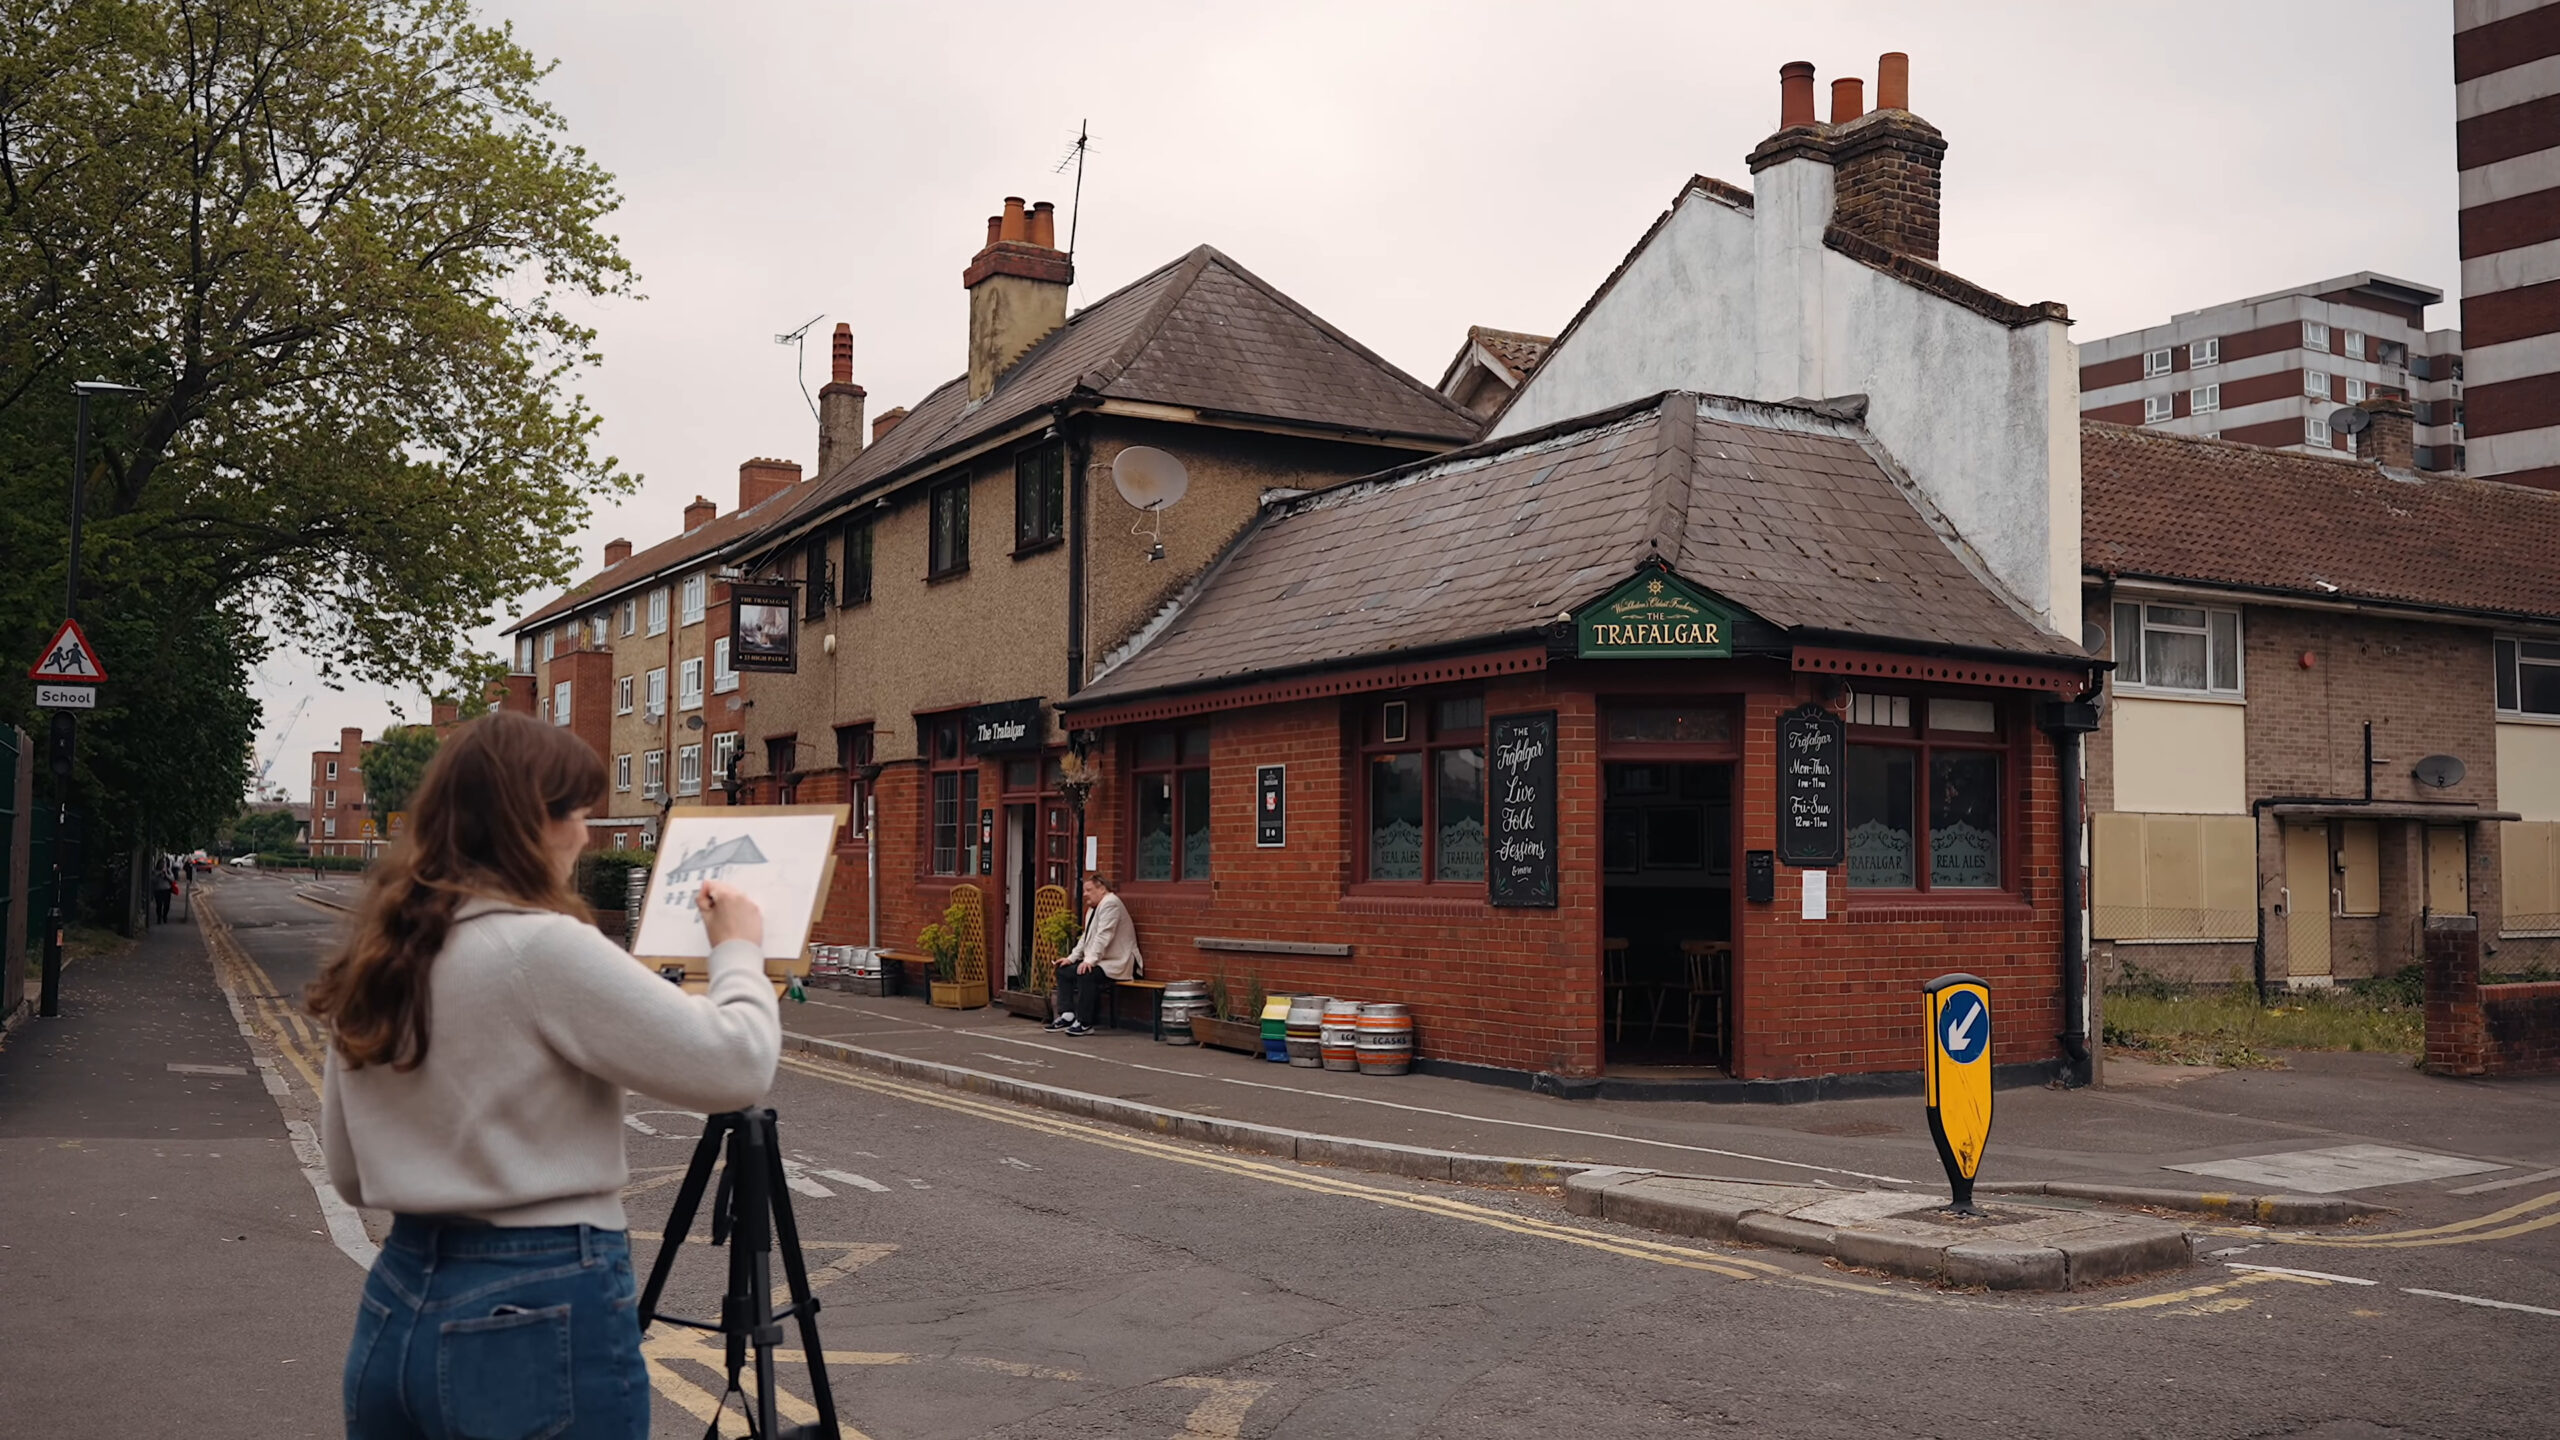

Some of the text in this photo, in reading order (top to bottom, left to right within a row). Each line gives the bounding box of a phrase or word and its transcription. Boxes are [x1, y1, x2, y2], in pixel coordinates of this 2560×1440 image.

[1647, 612, 1665, 621] THE
[1592, 623, 1720, 646] TRAFALGAR
[41, 690, 91, 704] School
[977, 720, 1026, 742] The Trafalgar
[1512, 727, 1529, 737] THE
[1805, 722, 1819, 730] THE
[1789, 730, 1832, 754] Trafalgar
[1497, 737, 1544, 776] Trafalgar
[1504, 775, 1536, 804] Live
[1501, 806, 1536, 833] Folk
[1495, 836, 1547, 862] Sessions
[1381, 850, 1420, 864] REAL ALES
[1446, 851, 1485, 865] TRAFALGA
[1936, 854, 1986, 869] REAL ALES
[1372, 1036, 1407, 1046] ECASKS
